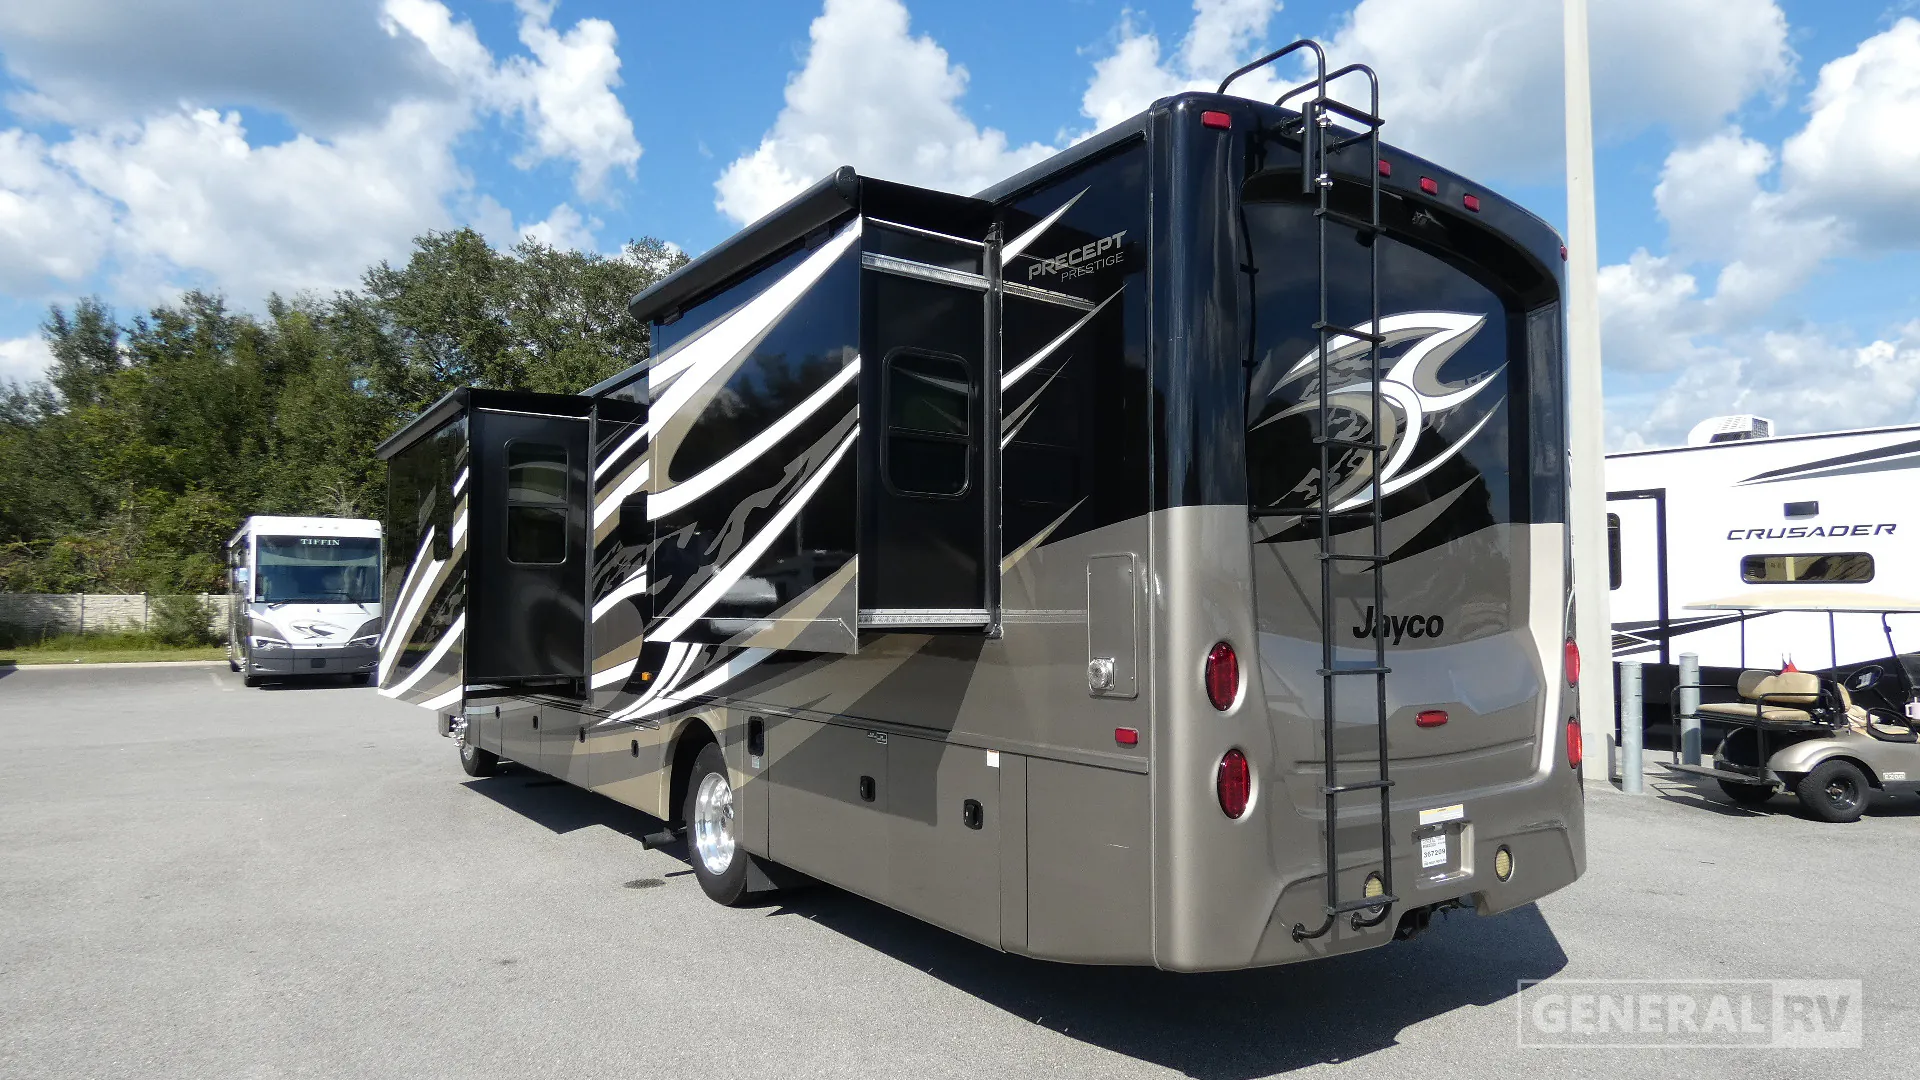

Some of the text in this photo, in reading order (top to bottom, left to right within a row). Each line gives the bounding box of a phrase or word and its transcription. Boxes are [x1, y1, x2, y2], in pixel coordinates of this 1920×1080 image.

[1028, 229, 1128, 281] PRECEPT
[1061, 251, 1124, 282] PRESTIGE
[300, 538, 340, 546] TIFFIN
[1727, 523, 1897, 541] CRUSADER
[1352, 605, 1444, 646] Jayco
